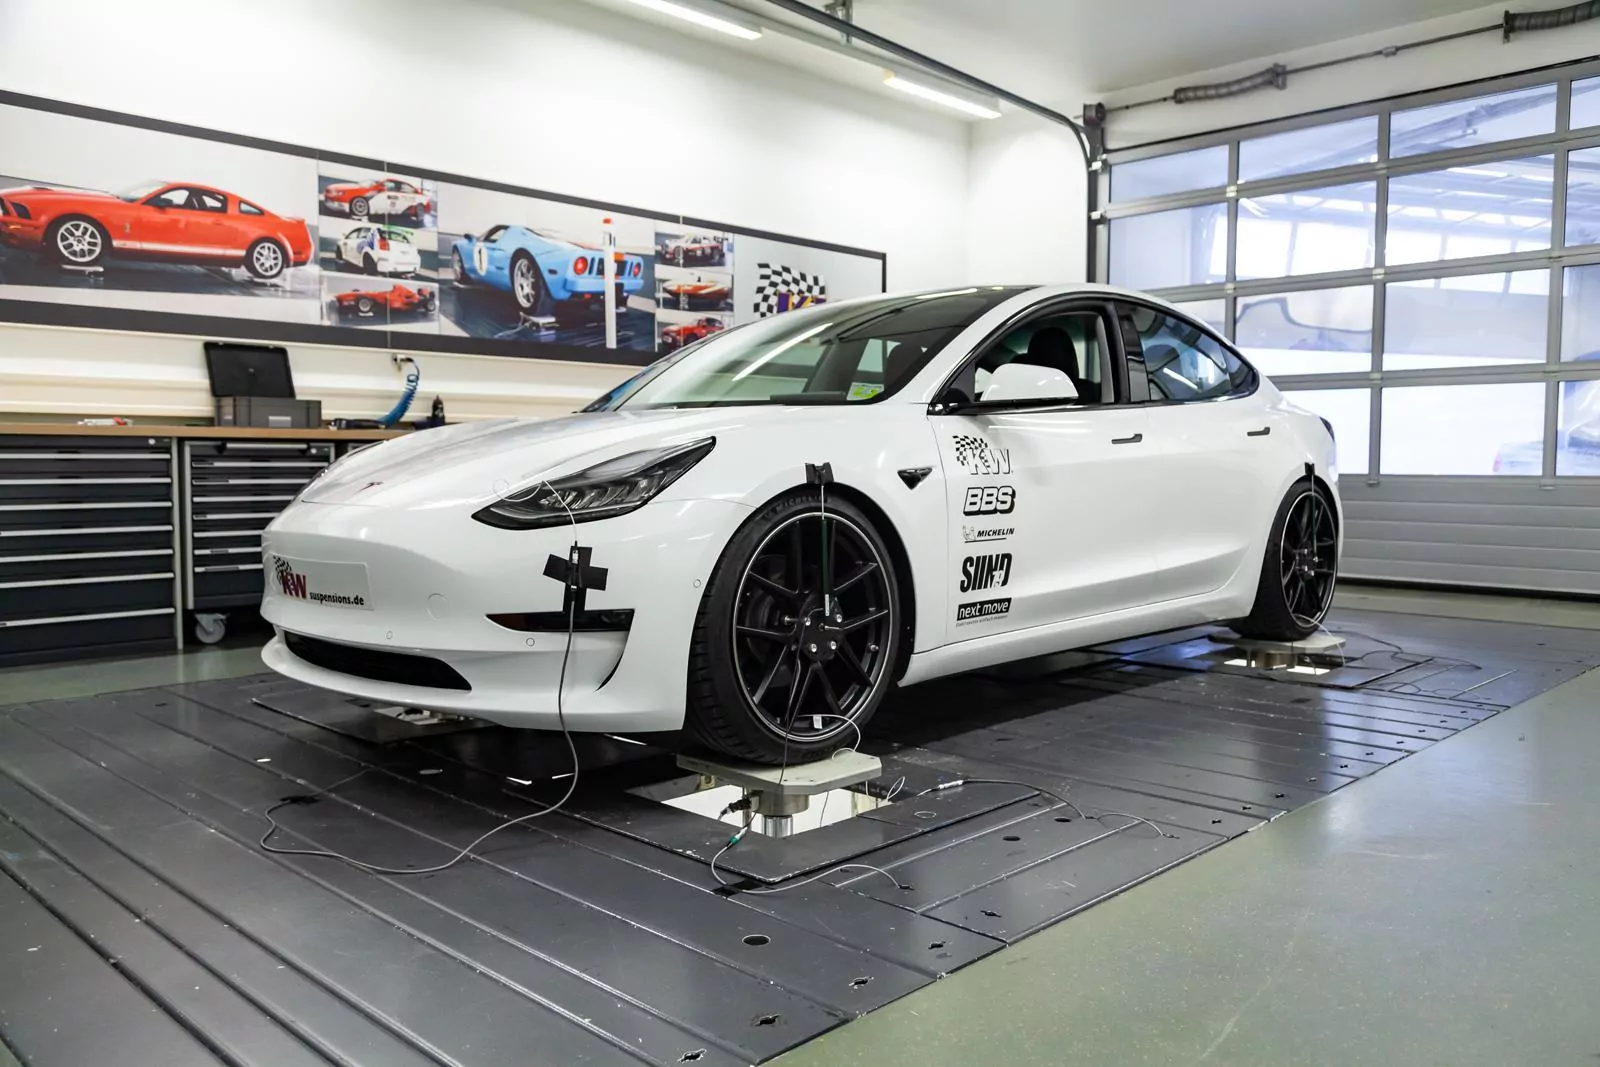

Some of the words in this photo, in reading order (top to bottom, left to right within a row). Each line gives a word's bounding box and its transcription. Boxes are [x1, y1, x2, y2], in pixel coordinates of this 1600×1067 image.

[478, 247, 483, 271] 1
[966, 448, 1011, 475] KW
[963, 485, 1016, 516] BBS
[977, 527, 1015, 538] MICHELIN
[281, 571, 307, 600] KW
[309, 592, 365, 606] suspensions.de
[959, 603, 981, 619] next
[982, 601, 1009, 615] move
